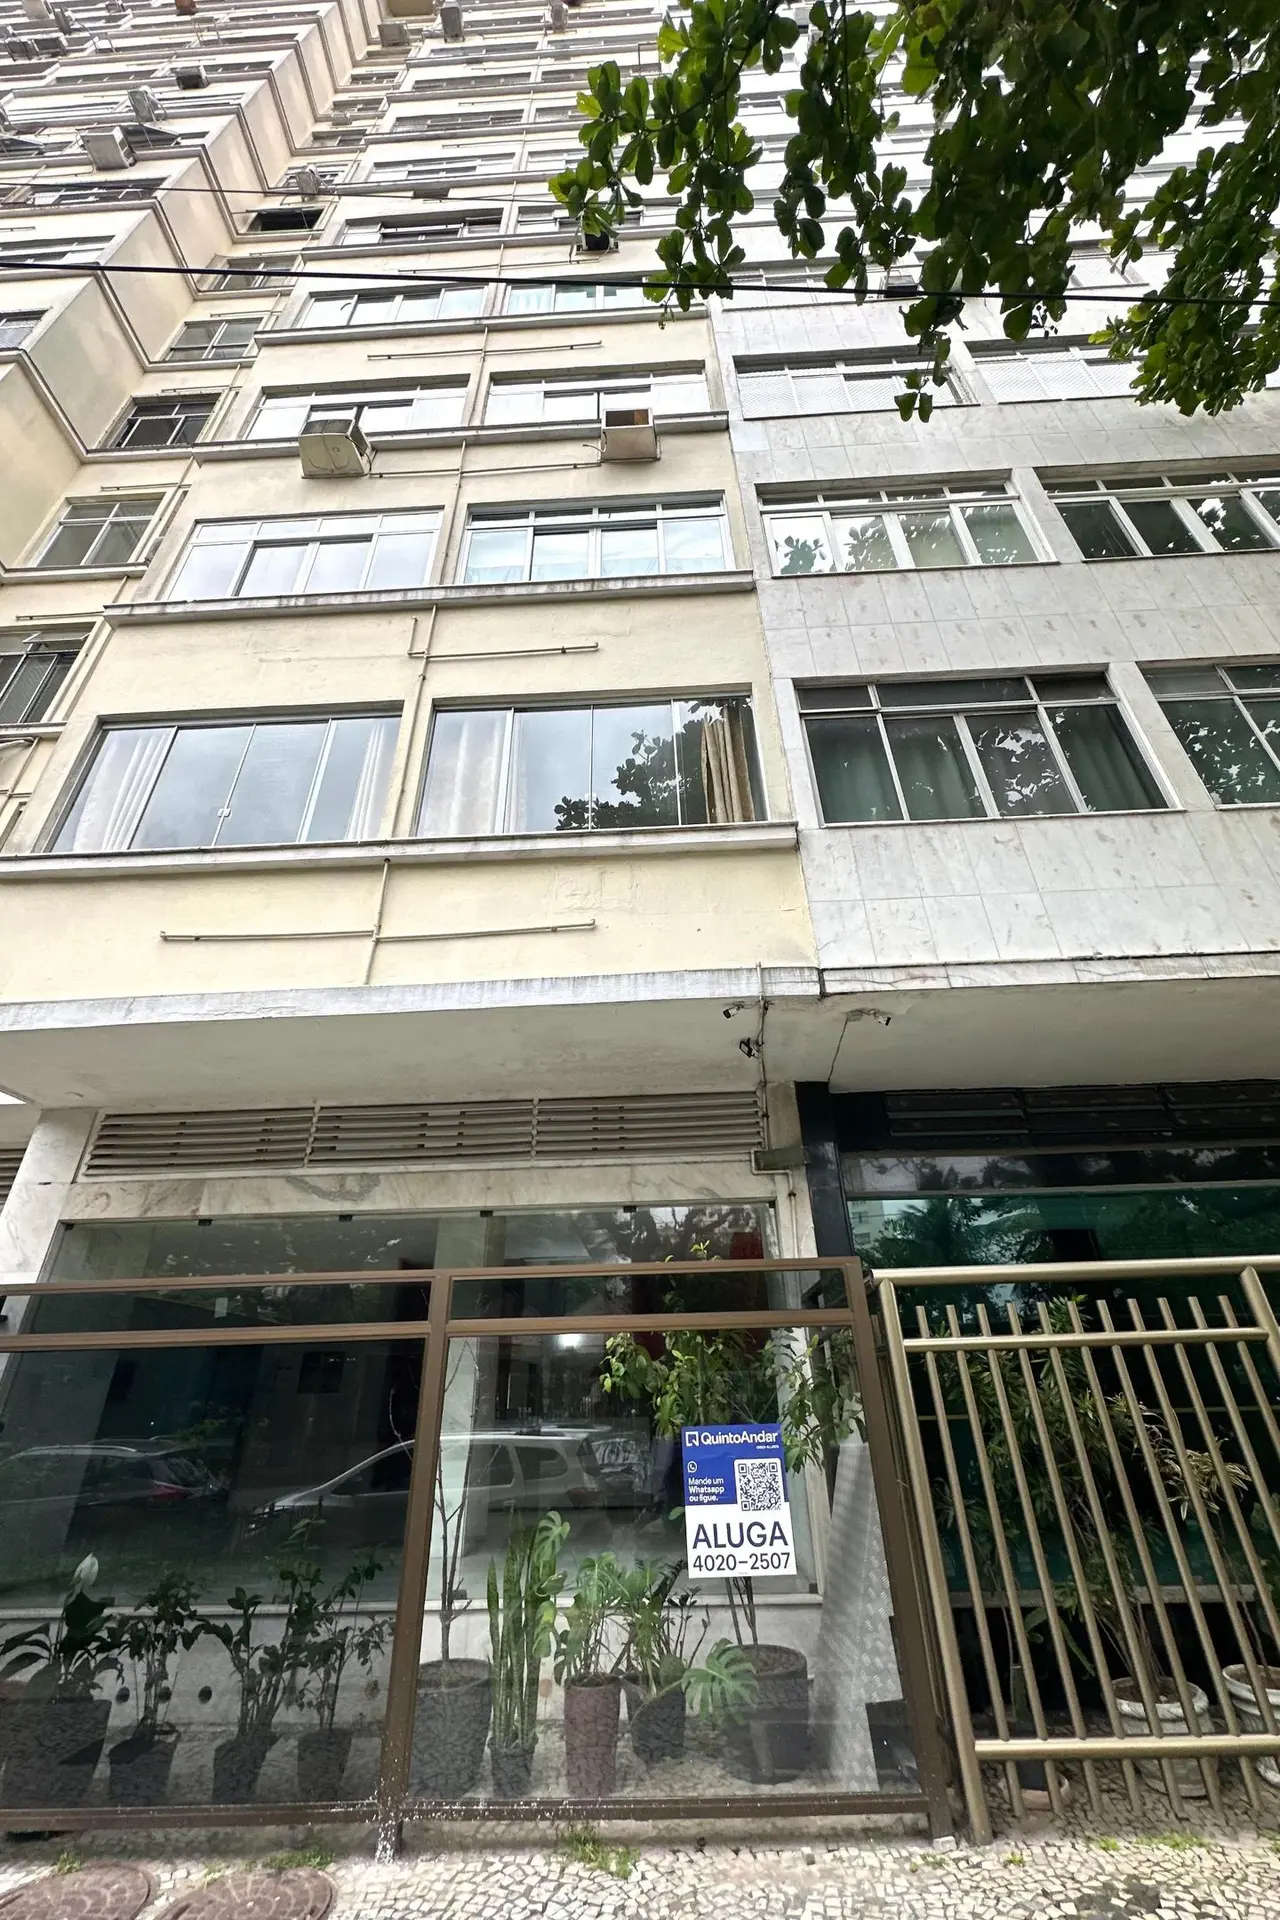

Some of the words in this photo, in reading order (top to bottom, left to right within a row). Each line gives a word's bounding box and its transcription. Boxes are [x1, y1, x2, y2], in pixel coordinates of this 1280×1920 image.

[701, 1430, 779, 1445] QuintoAndar
[688, 1477, 712, 1486] Mande
[688, 1486, 725, 1495] Whatsapp
[692, 1521, 789, 1549] ALUGA
[693, 1552, 790, 1572] 4020-2507
